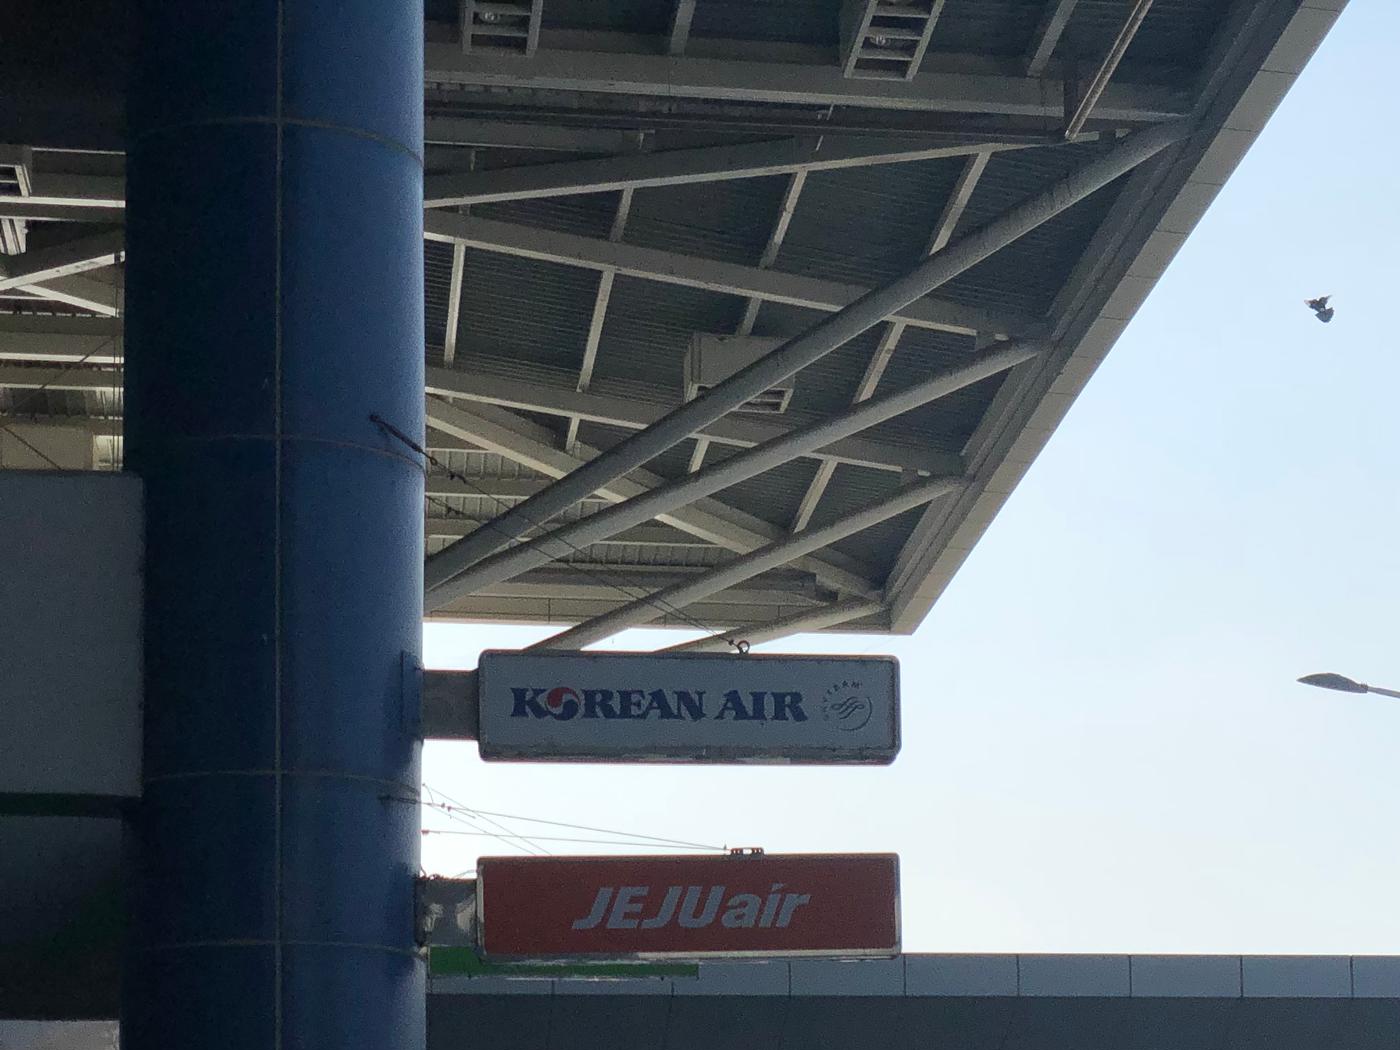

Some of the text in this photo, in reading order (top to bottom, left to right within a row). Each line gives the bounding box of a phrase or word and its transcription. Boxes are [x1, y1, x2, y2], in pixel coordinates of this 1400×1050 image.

[510, 686, 808, 723] KOREAN AIR
[572, 882, 812, 930] JEJUair
